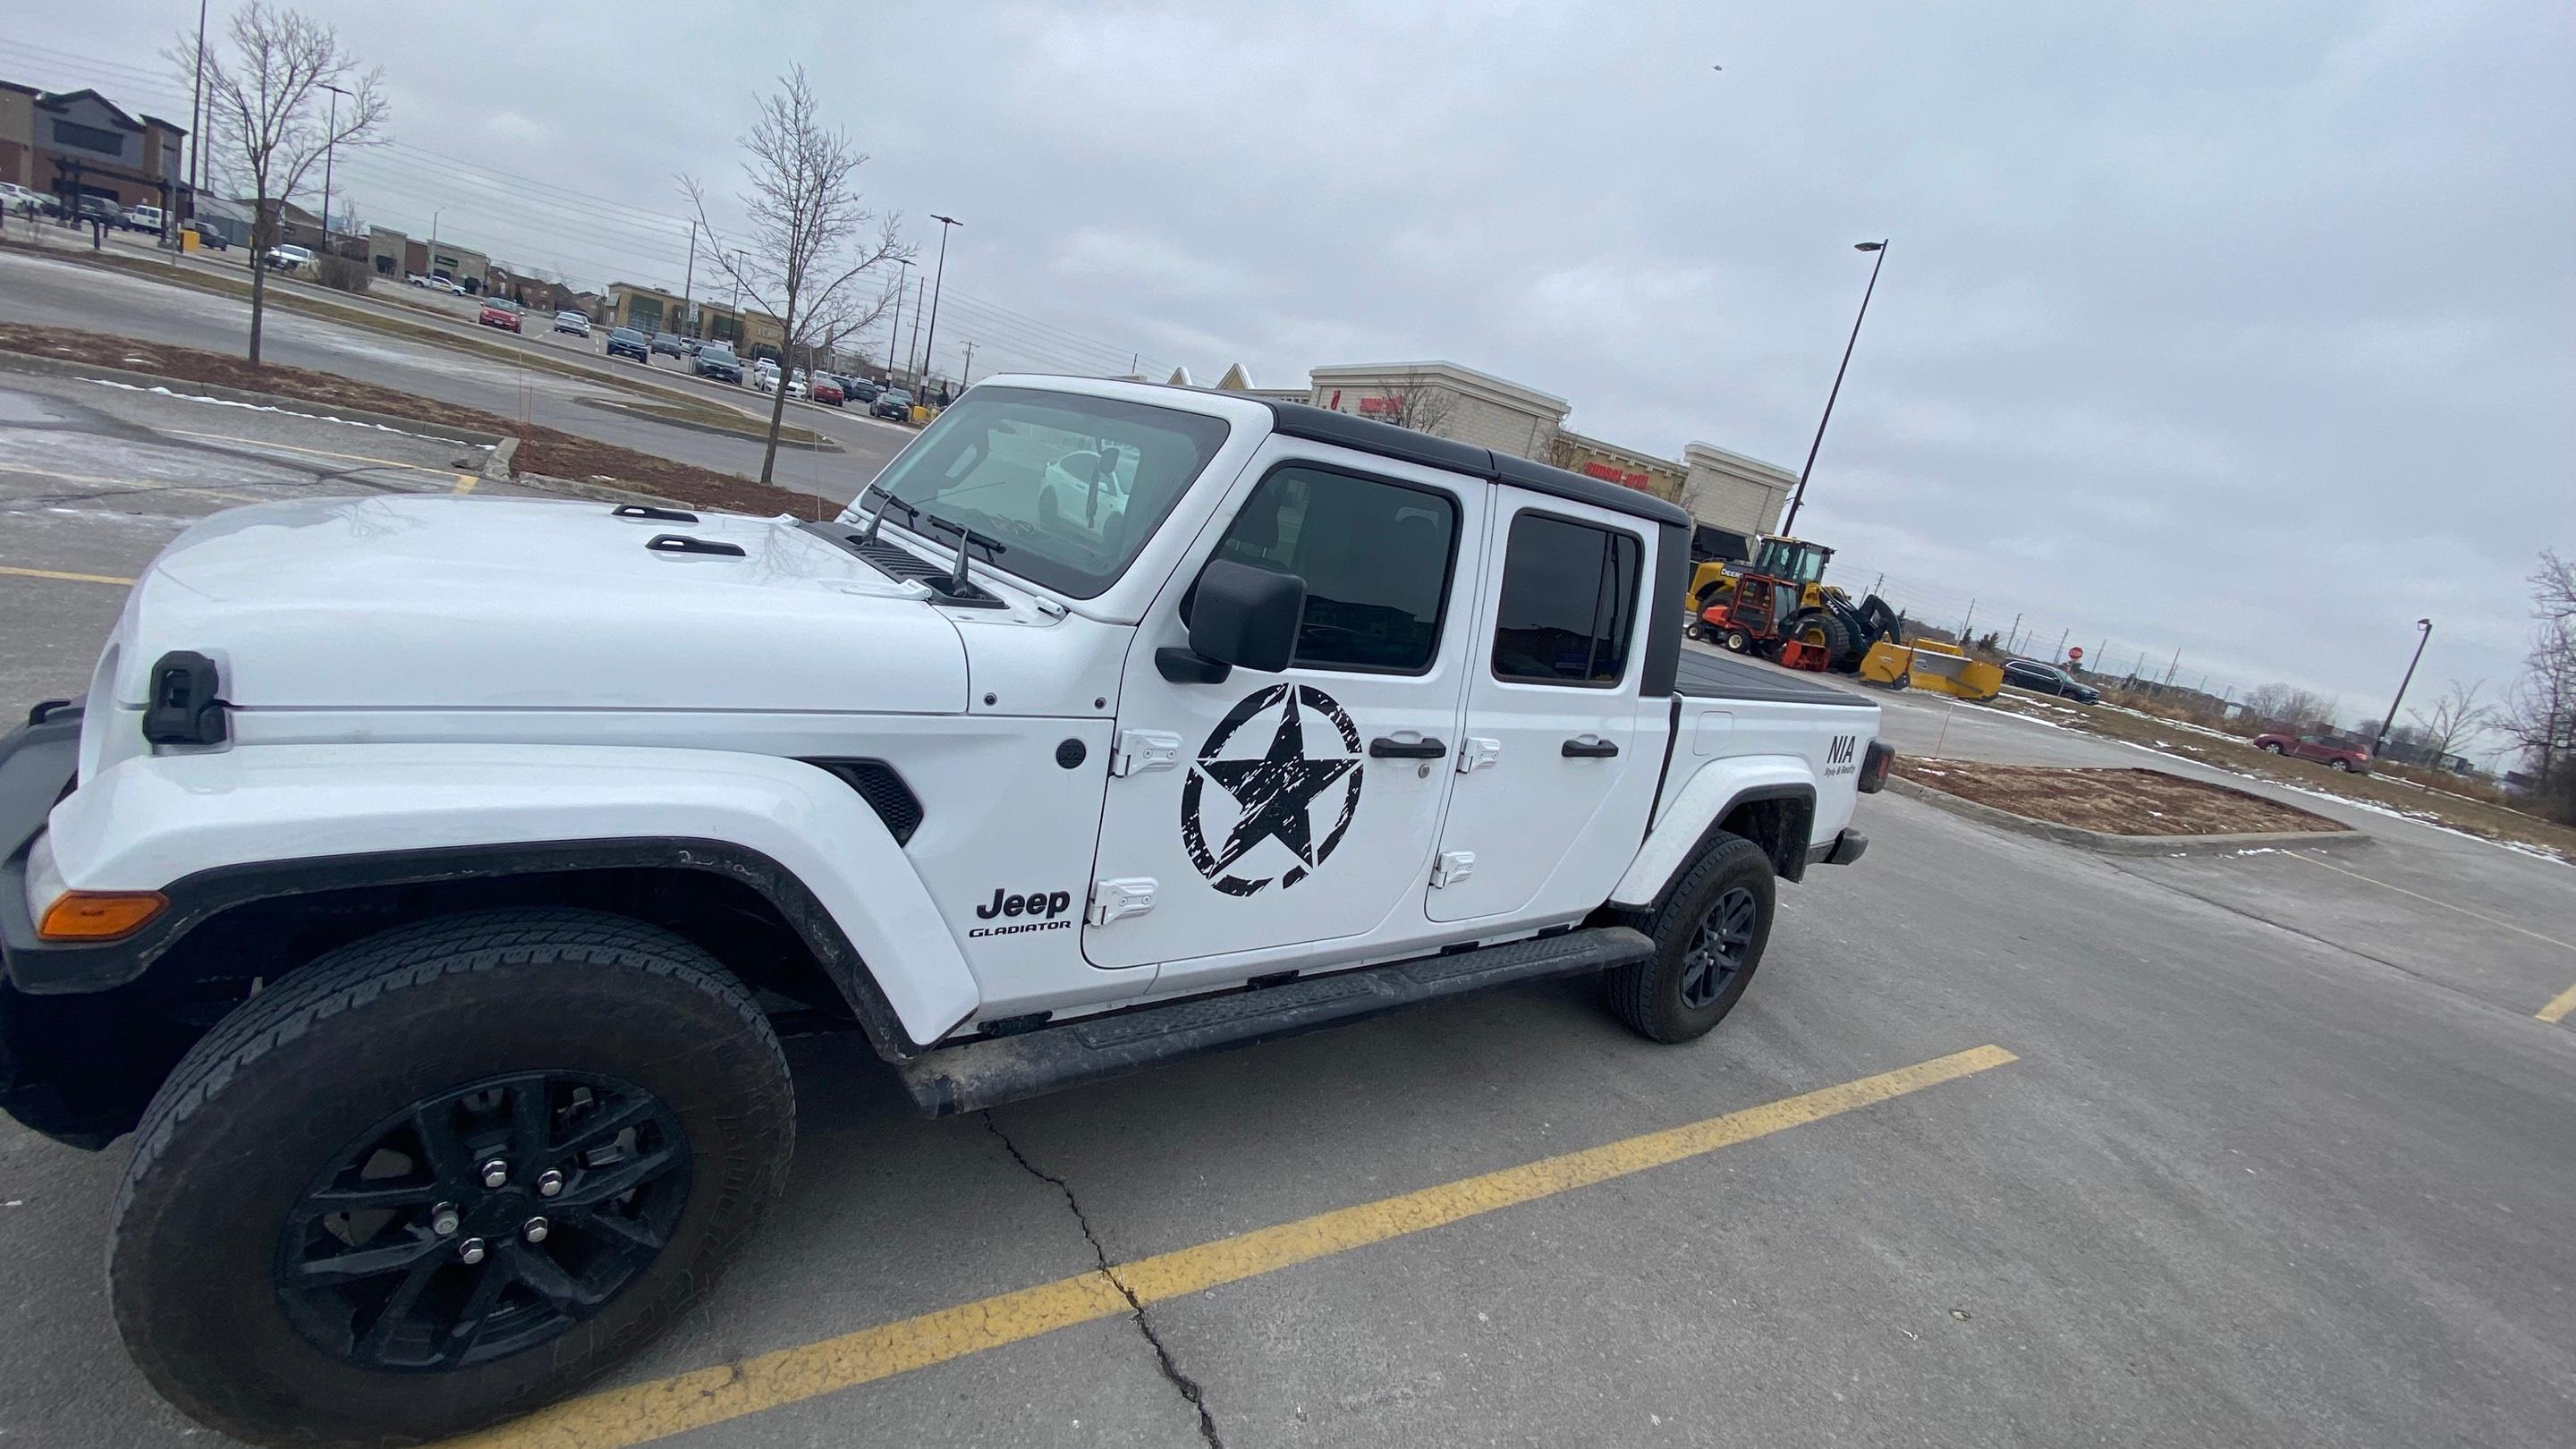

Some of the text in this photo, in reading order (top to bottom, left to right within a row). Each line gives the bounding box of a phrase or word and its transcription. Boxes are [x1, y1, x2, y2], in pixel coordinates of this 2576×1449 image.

[1826, 735, 1855, 764] NIA
[976, 888, 1071, 919] Jeep
[969, 920, 1072, 938] GLADIATOR
